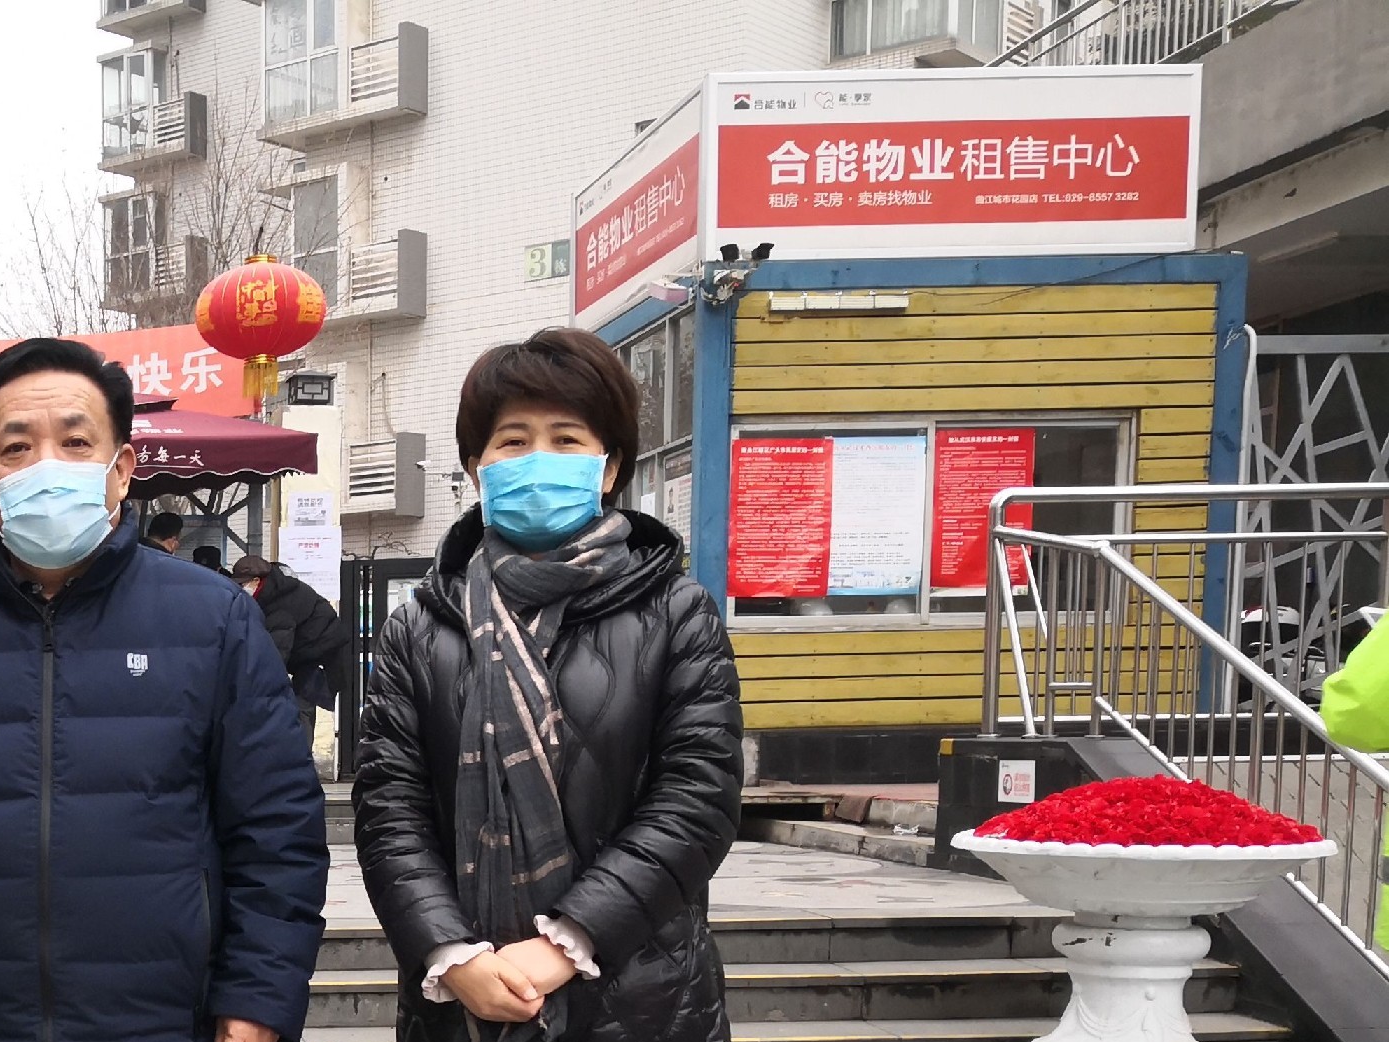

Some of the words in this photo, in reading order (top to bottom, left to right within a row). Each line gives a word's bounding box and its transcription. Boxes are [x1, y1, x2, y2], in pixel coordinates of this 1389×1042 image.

[754, 98, 797, 110] 合能物业
[766, 133, 1140, 186] 合能物业租售中心
[586, 165, 686, 272] 合能物业租售中心
[127, 348, 224, 397] 快乐
